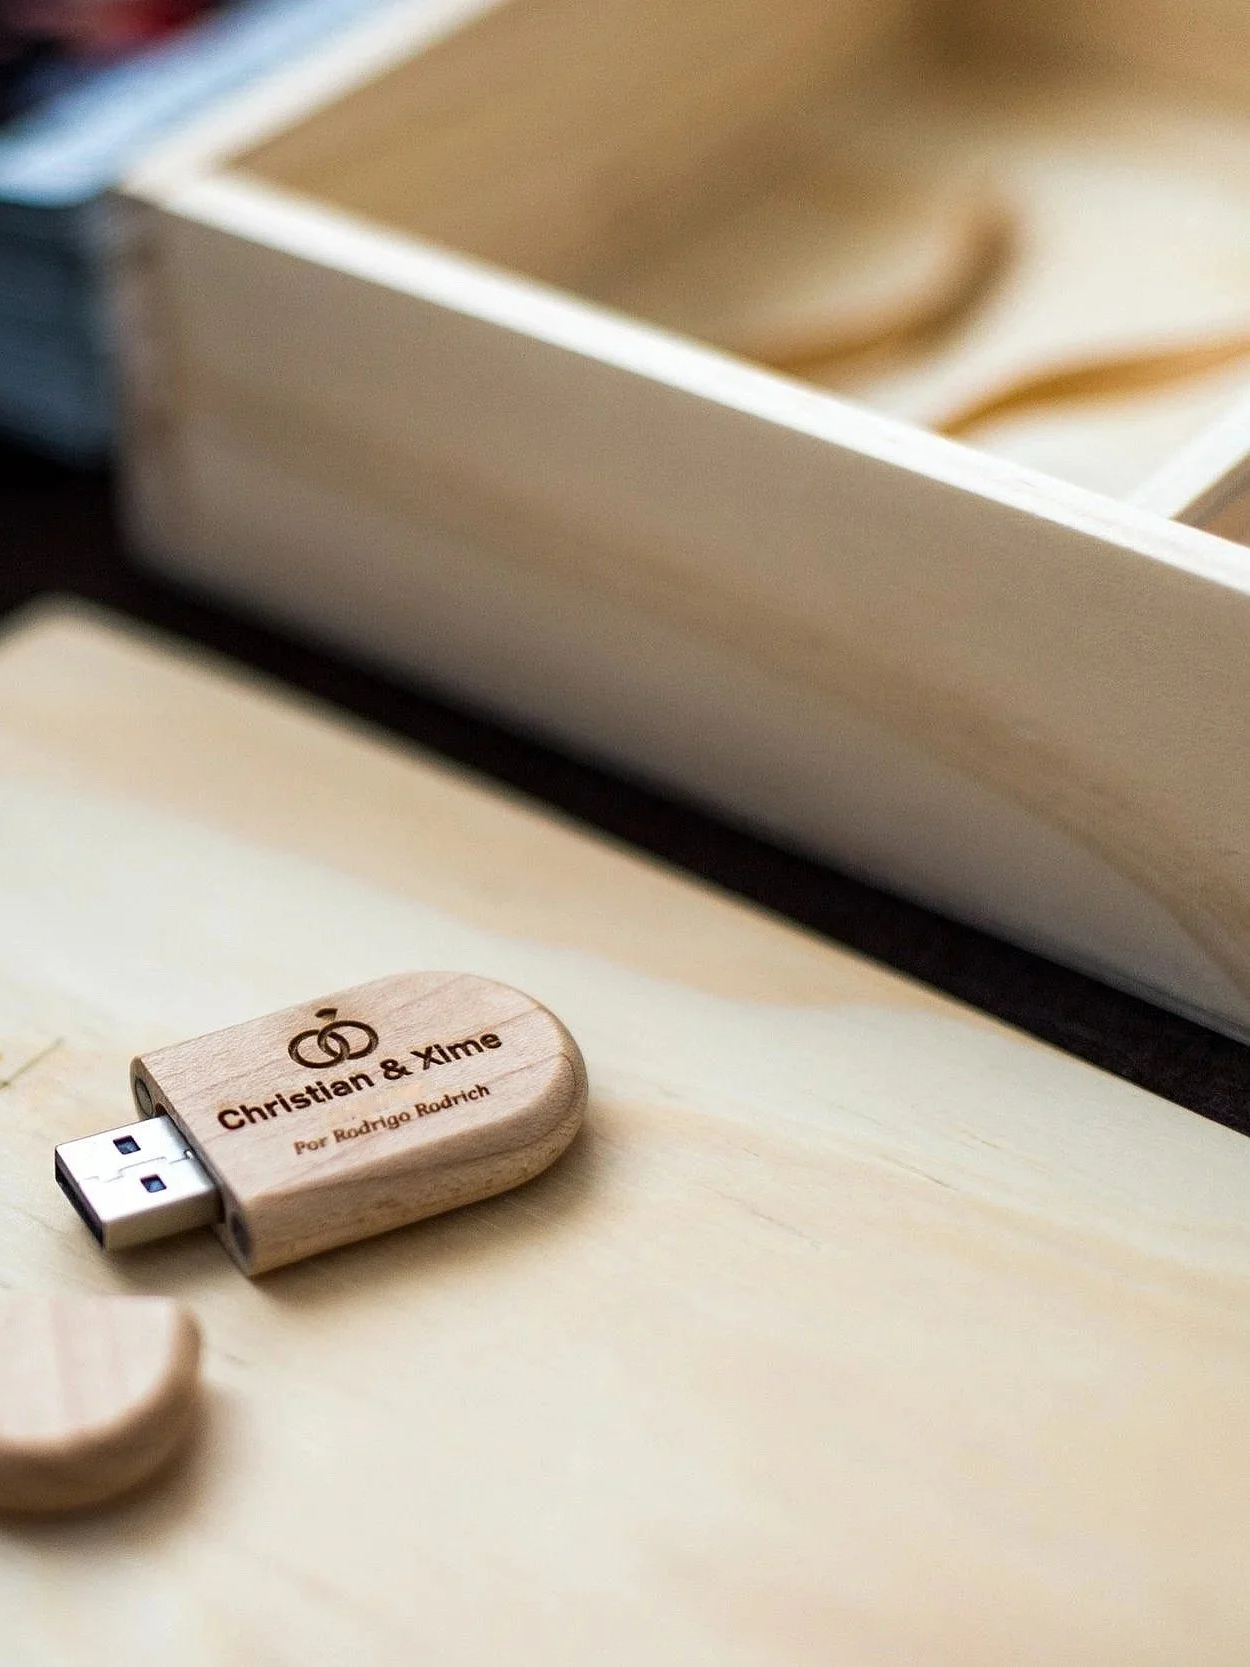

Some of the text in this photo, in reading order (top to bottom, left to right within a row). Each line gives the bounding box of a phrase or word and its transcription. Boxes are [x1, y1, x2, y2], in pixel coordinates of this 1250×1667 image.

[217, 1032, 503, 1130] Christian & Xime
[293, 1084, 491, 1155] Por Rodrigo Rodrich
